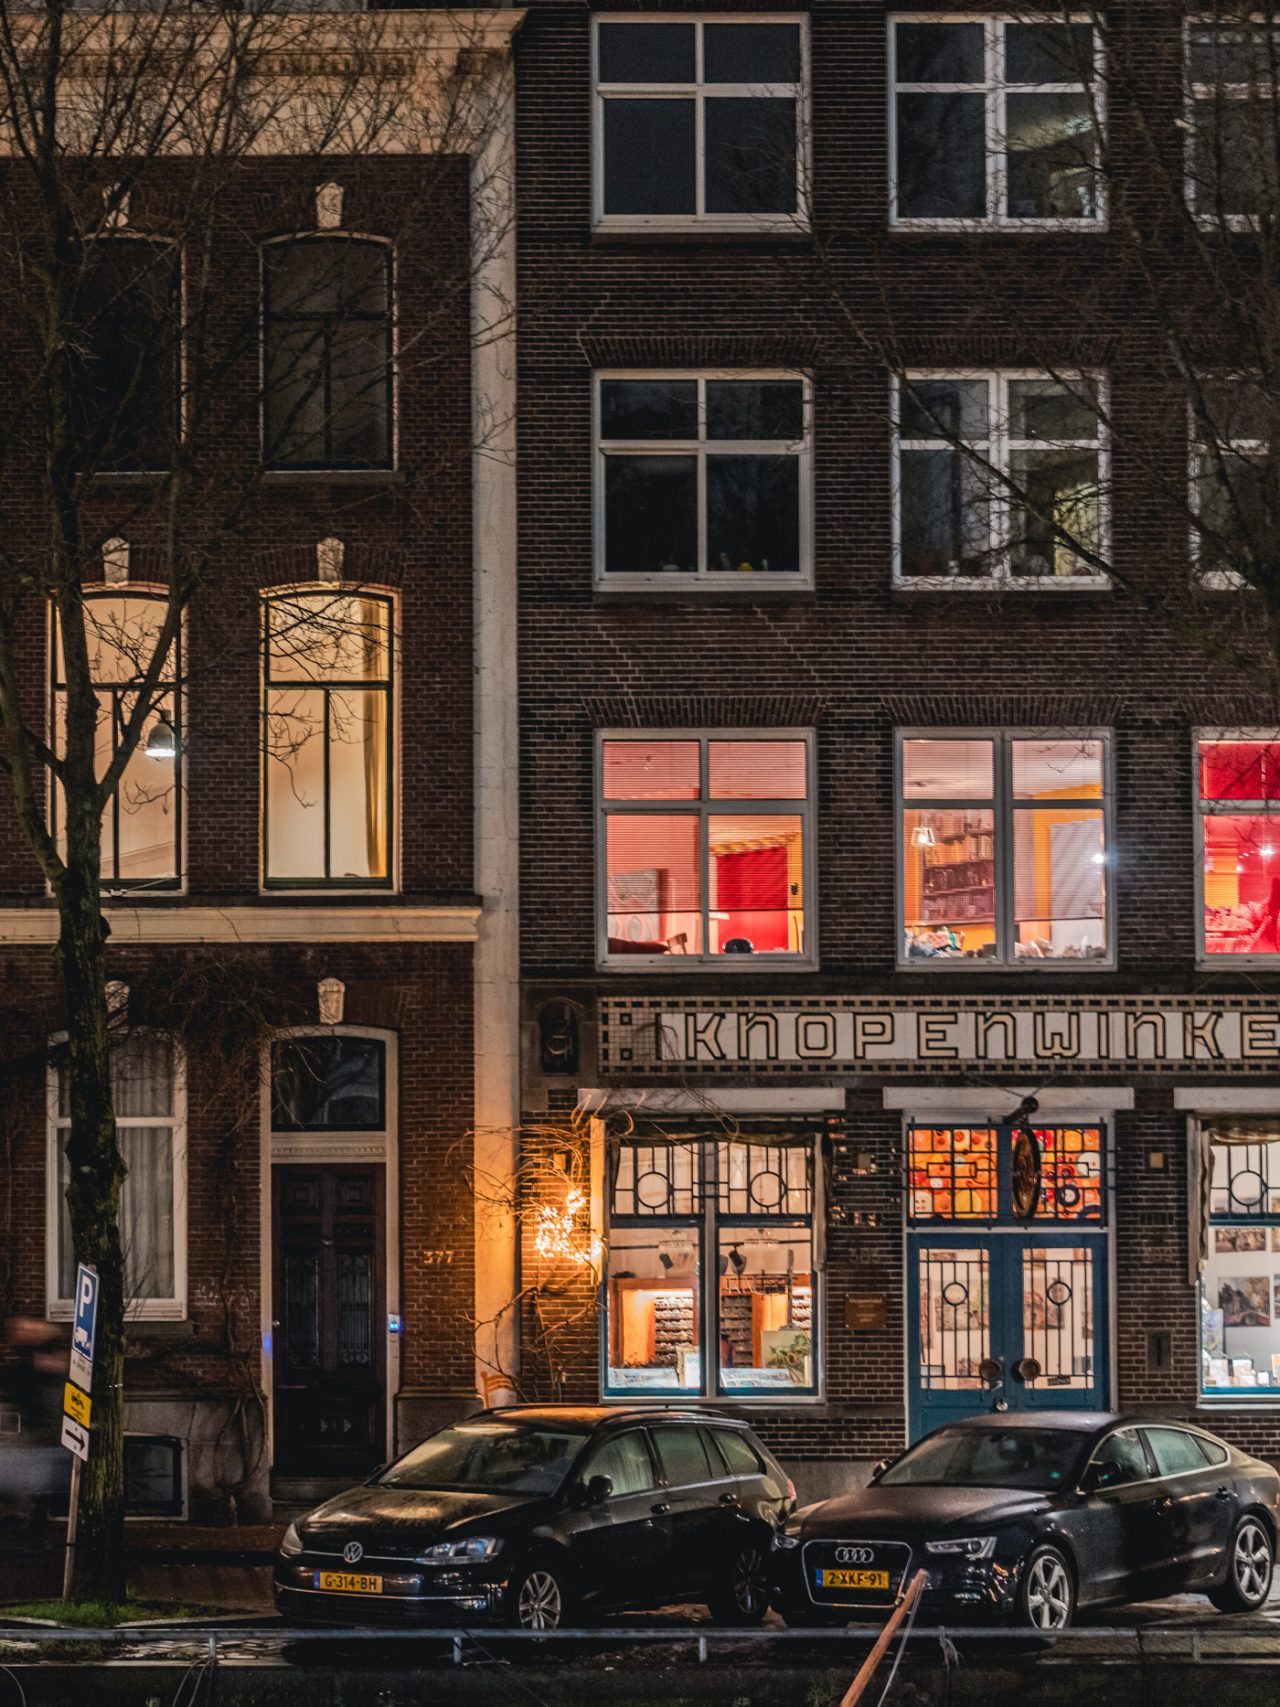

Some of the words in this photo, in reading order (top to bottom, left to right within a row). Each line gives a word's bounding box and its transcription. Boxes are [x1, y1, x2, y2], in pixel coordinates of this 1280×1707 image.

[423, 1250, 454, 1264] 377
[79, 1274, 93, 1318] P
[324, 1574, 377, 1591] G-314-BH
[828, 1571, 882, 1586] 2-XKF-91
